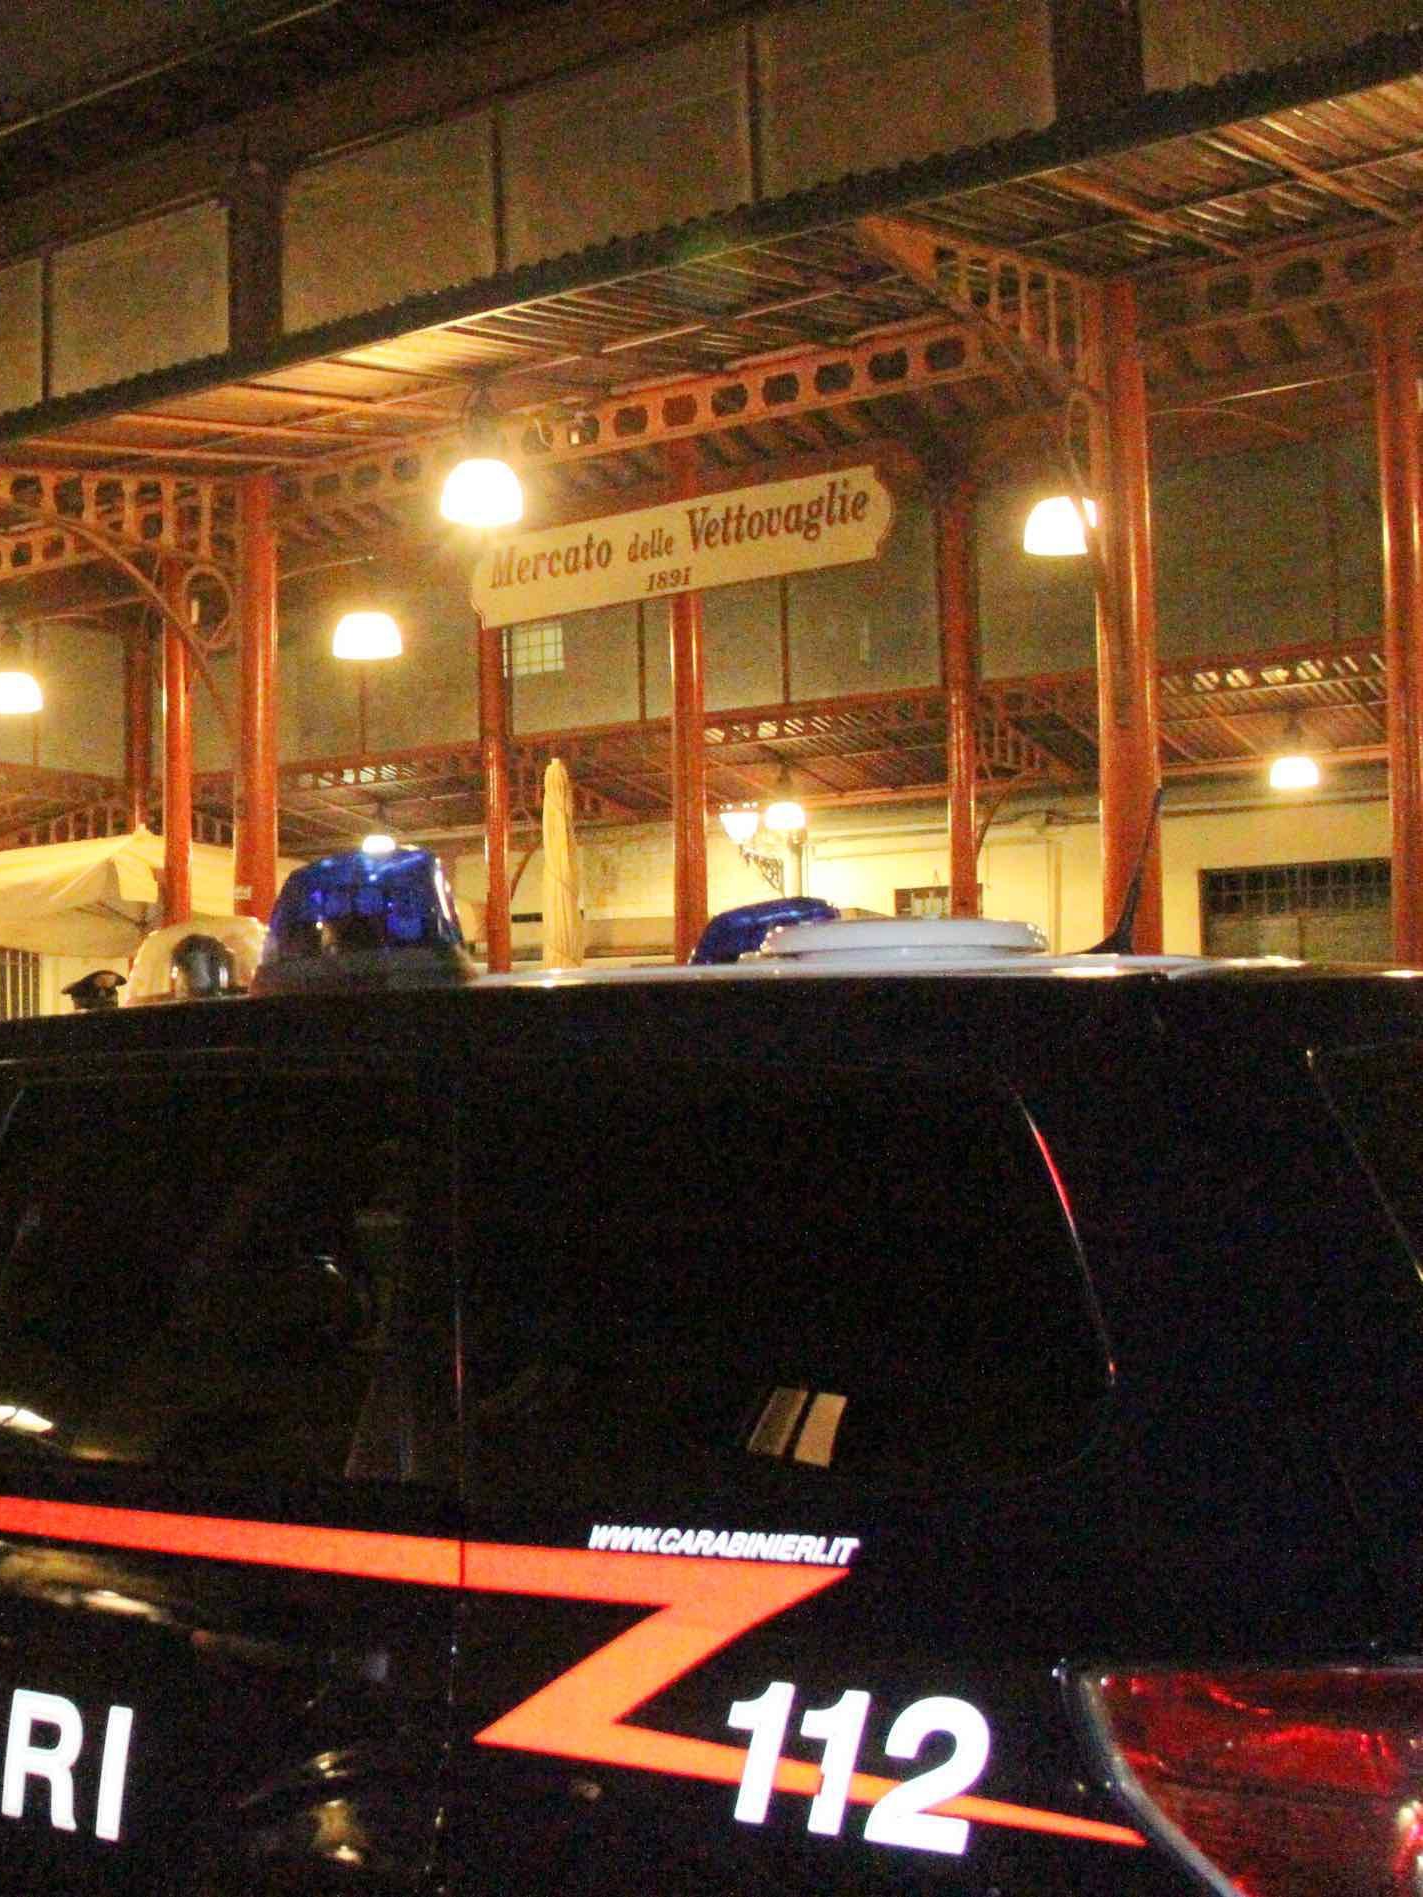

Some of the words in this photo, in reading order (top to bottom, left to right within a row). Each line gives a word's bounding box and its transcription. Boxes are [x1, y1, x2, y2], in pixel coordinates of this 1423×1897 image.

[489, 532, 613, 589] Mercato
[627, 527, 675, 563] delle
[685, 478, 871, 552] Vettovaglie
[587, 1524, 861, 1566] WWW.CARABINIERI.IT
[726, 1680, 991, 1856] 112
